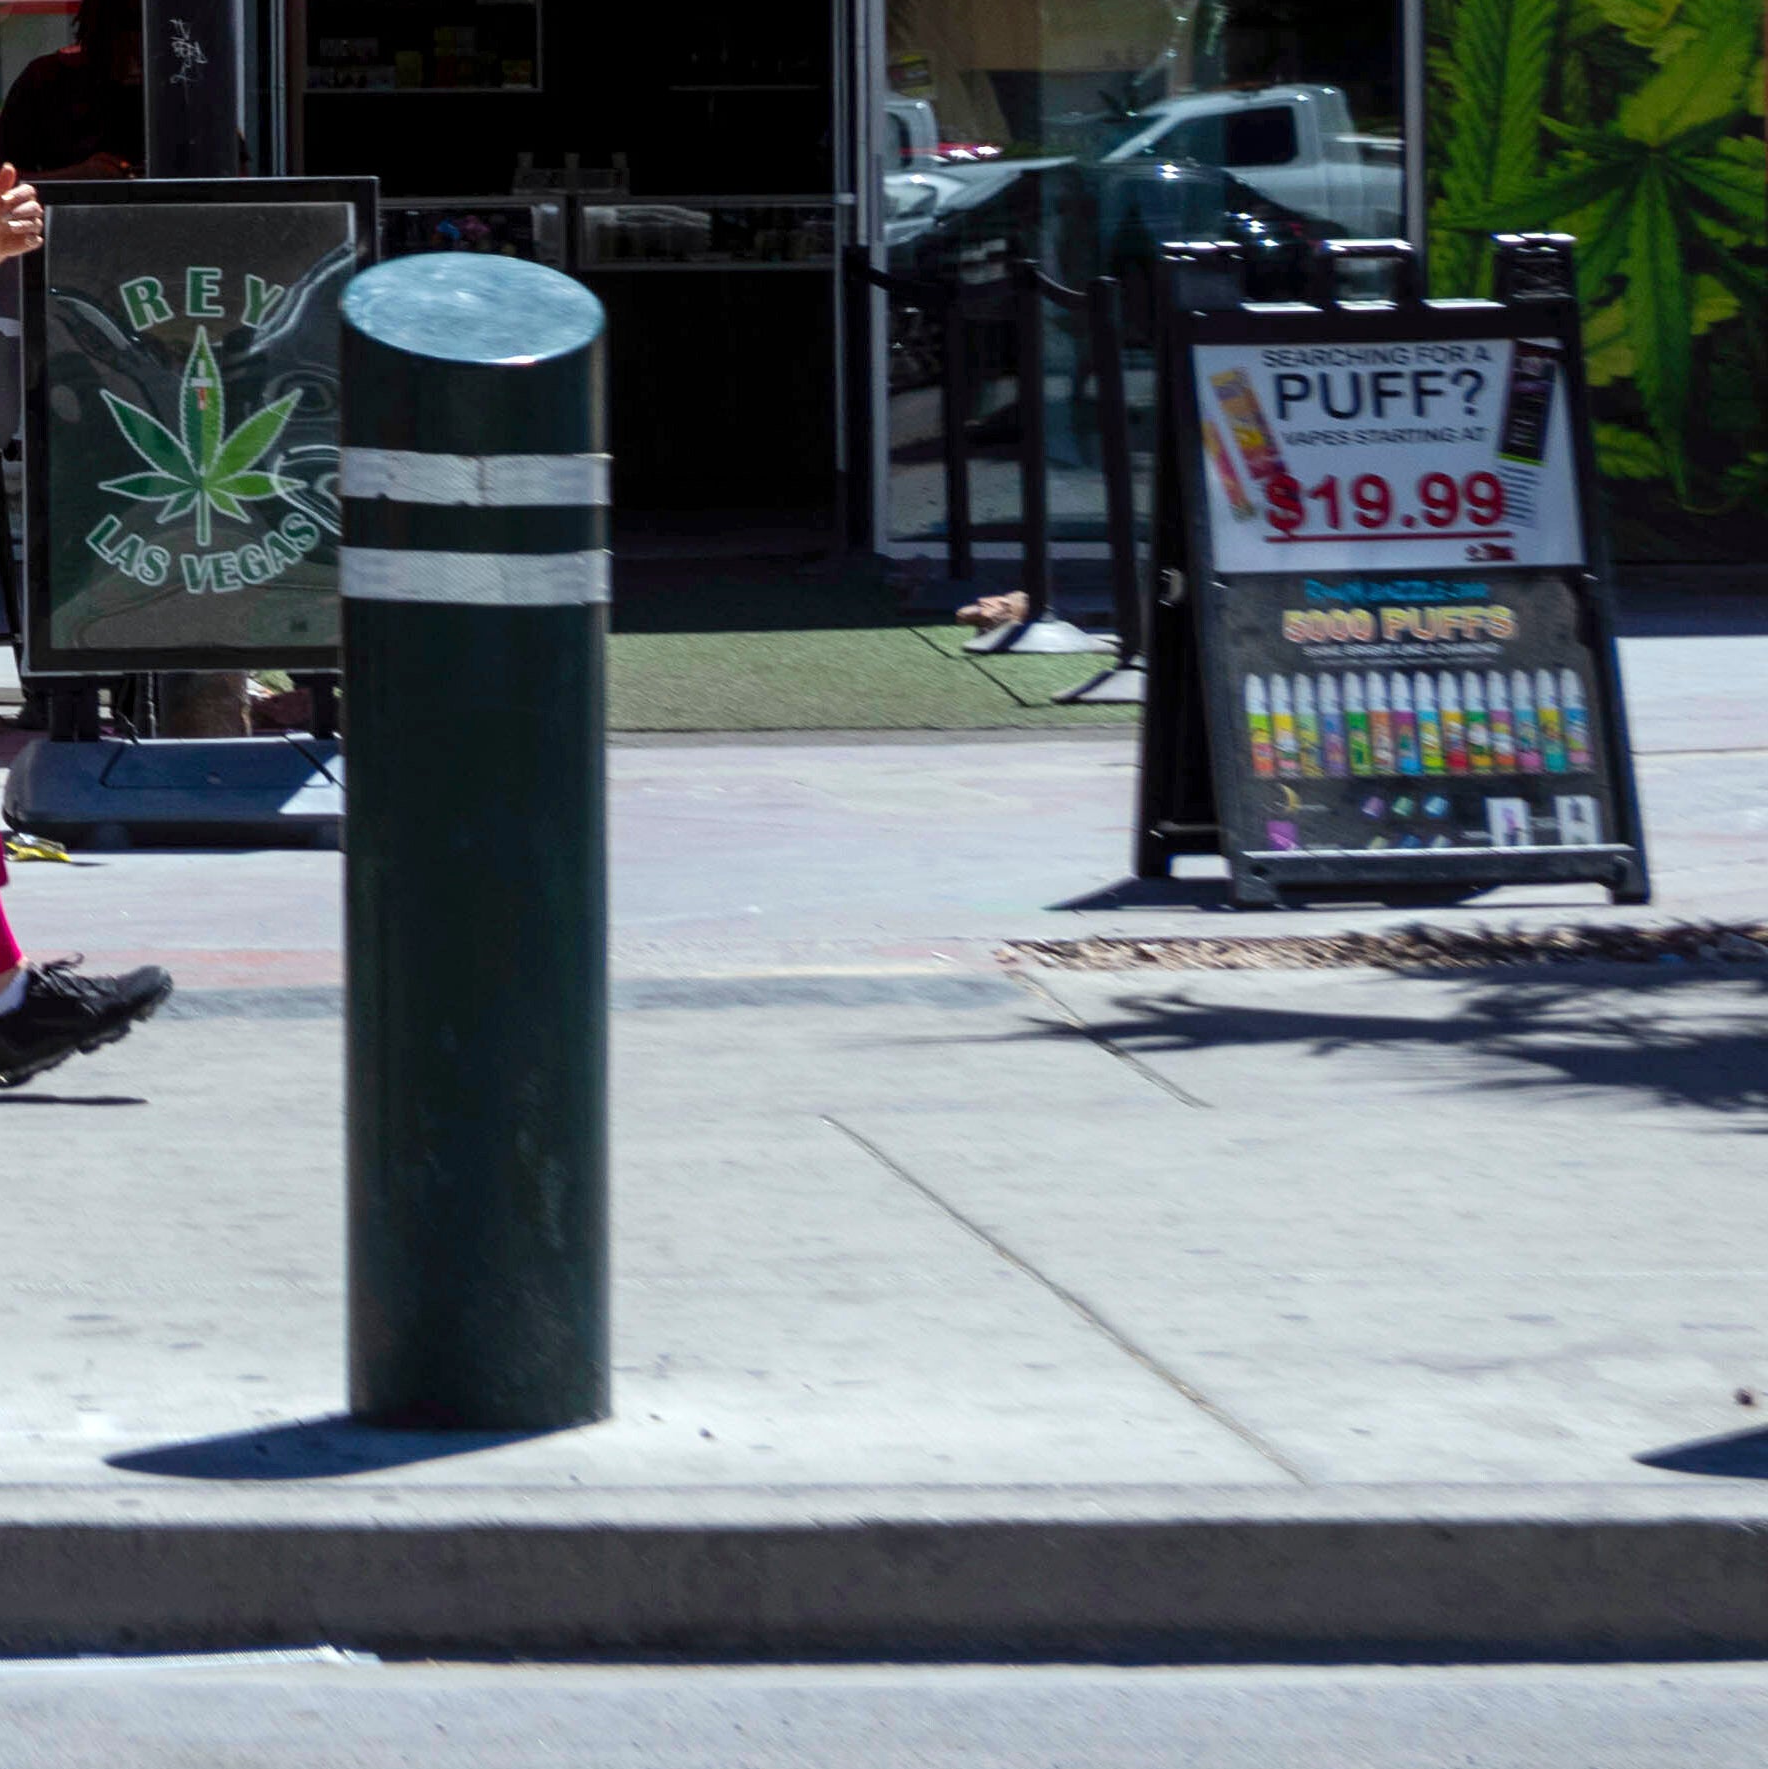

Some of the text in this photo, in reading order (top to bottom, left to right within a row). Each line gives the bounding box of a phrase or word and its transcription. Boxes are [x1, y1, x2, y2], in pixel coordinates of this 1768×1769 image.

[119, 266, 284, 331] REY
[1263, 344, 1493, 369] SEARCHING FOR A
[1273, 369, 1486, 422] PUFF?
[1284, 429, 1355, 447] VAPES
[1356, 428, 1455, 445] STARTING
[1265, 471, 1505, 537] $19.99
[85, 513, 320, 594] LAS VEGAS
[1379, 605, 1519, 641] PUFFS
